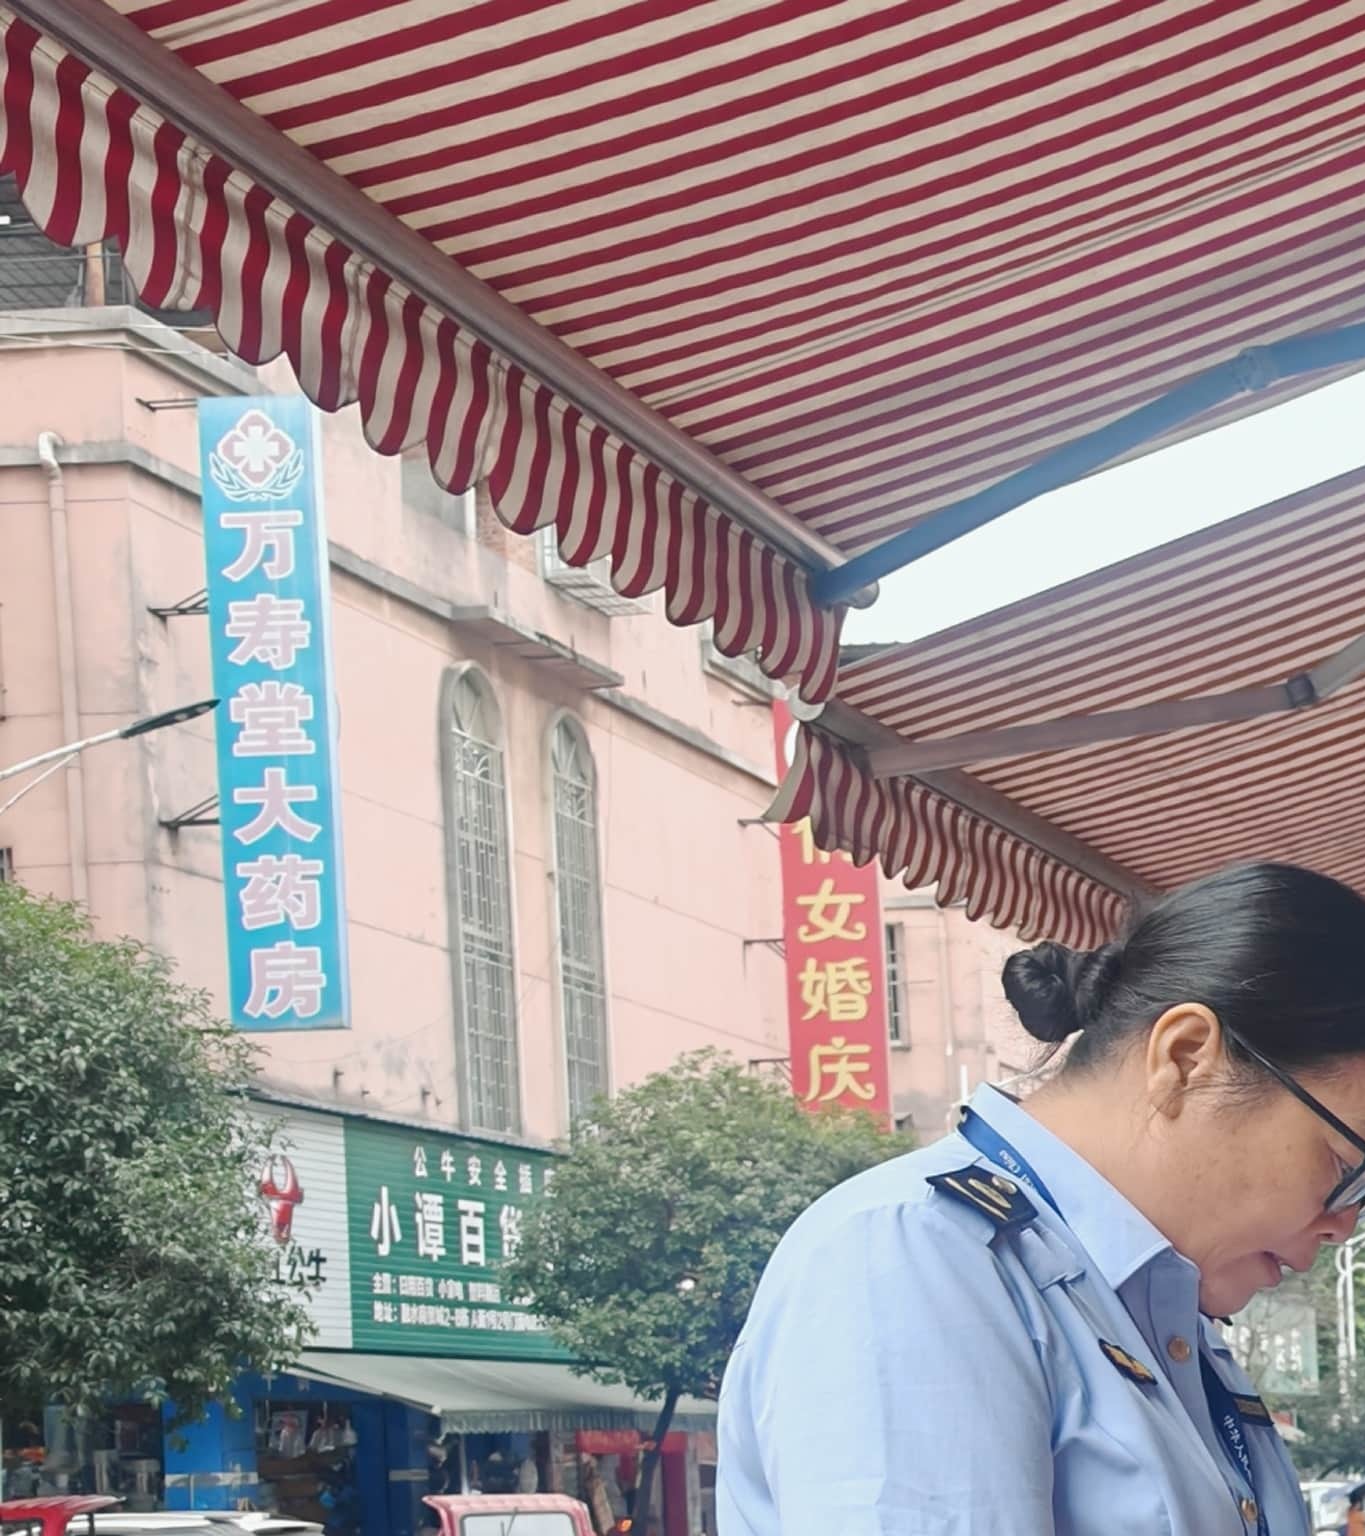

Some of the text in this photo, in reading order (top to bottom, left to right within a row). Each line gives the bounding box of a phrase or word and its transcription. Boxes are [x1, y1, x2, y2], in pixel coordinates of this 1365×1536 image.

[220, 511, 326, 1018] 万寿堂大药房
[793, 816, 876, 1101] 女婚庆
